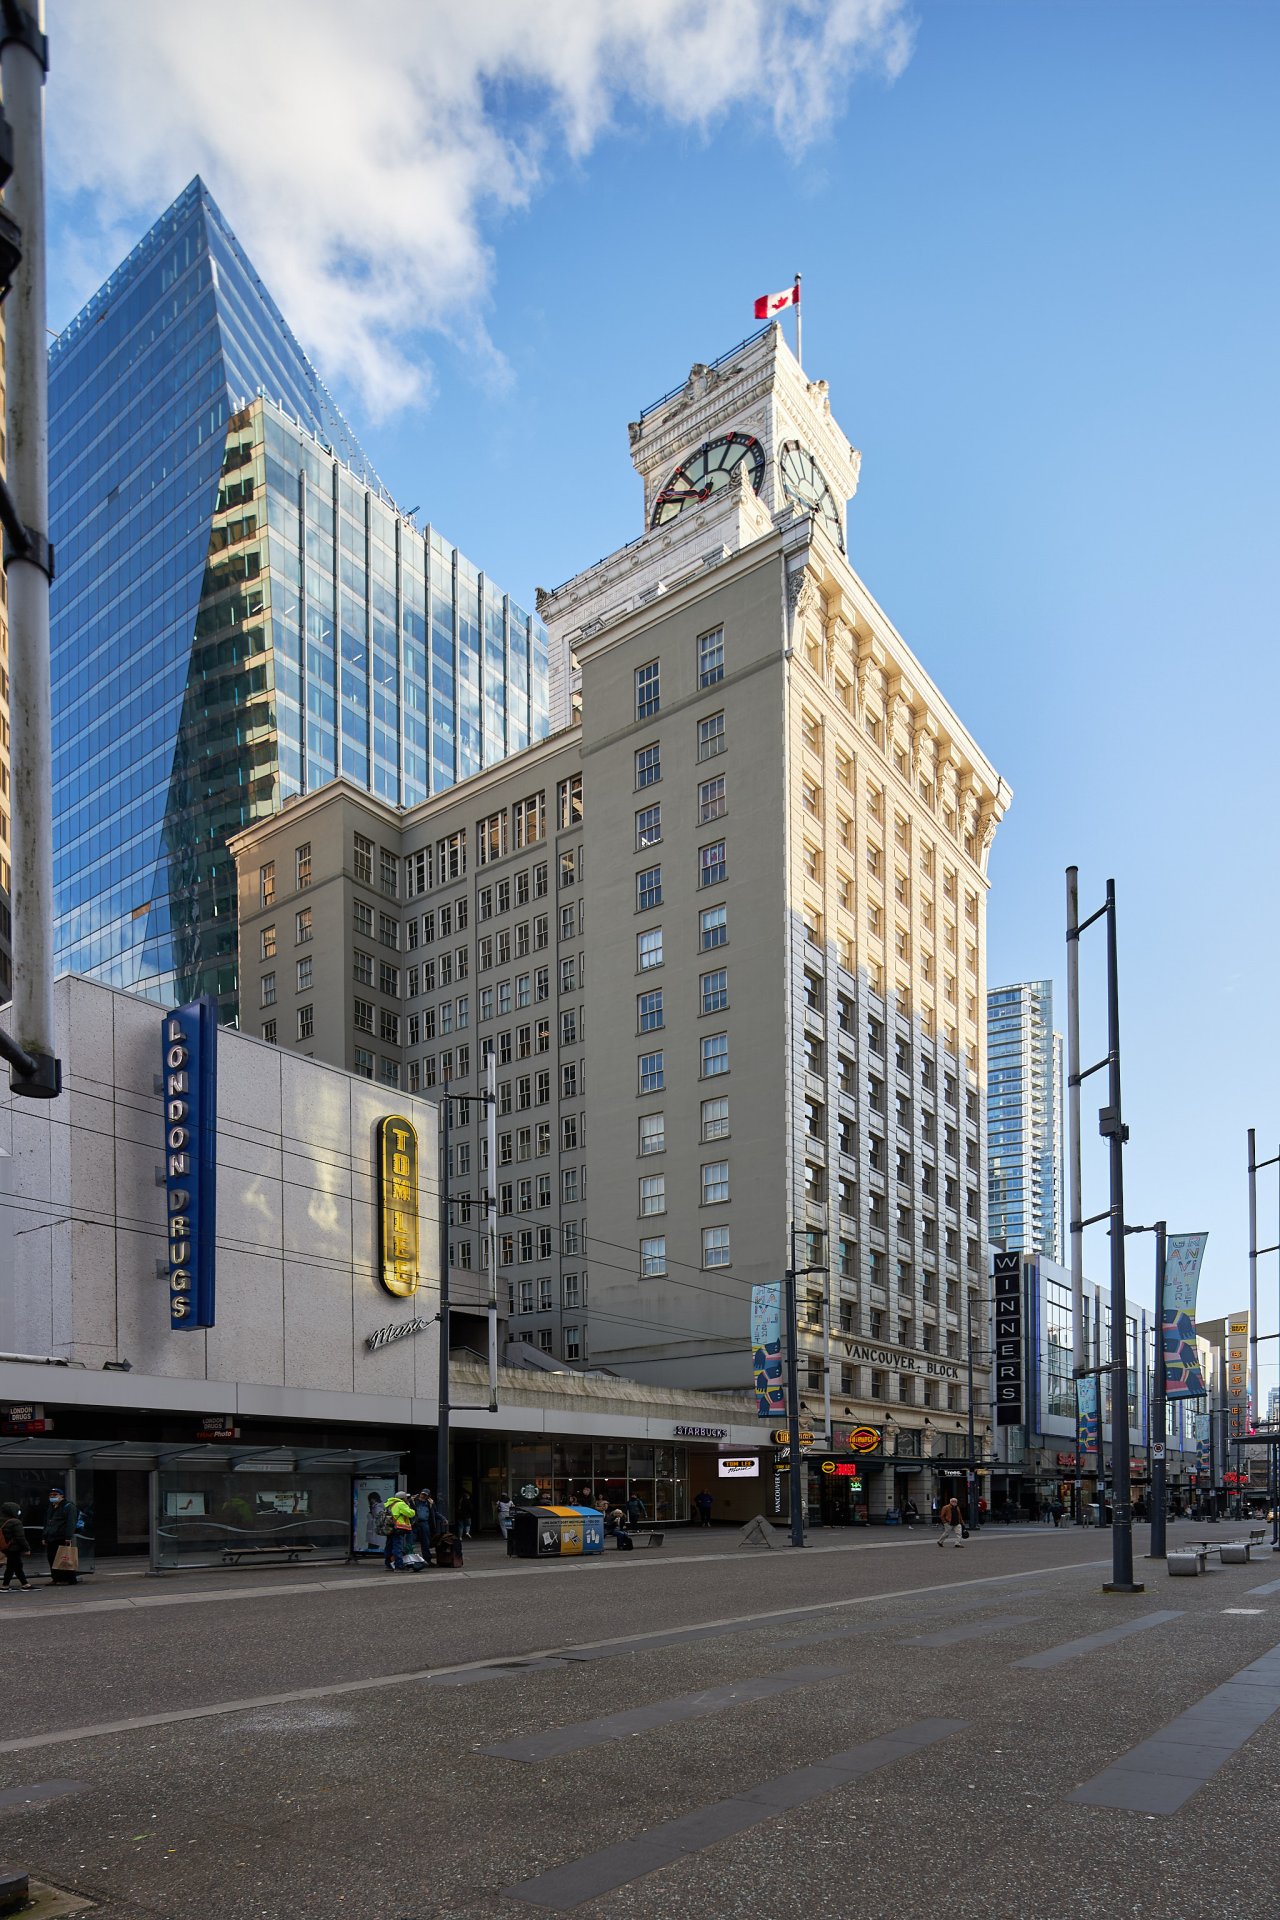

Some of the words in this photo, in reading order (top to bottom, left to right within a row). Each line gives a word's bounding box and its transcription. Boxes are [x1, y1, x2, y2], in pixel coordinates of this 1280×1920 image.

[167, 1018, 188, 1177] LONDON
[391, 1128, 411, 1202] TOM
[169, 1189, 191, 1318] DRUGS
[393, 1211, 411, 1285] LEE
[996, 1257, 1017, 1399] WINNERS
[844, 1343, 915, 1370] VANCOUVER
[927, 1361, 959, 1379] BLOCK
[1231, 1350, 1242, 1397] BEST
[10, 1406, 33, 1415] LONDON
[11, 1413, 32, 1421] DRUGS
[675, 1425, 728, 1439] STARBUCKS
